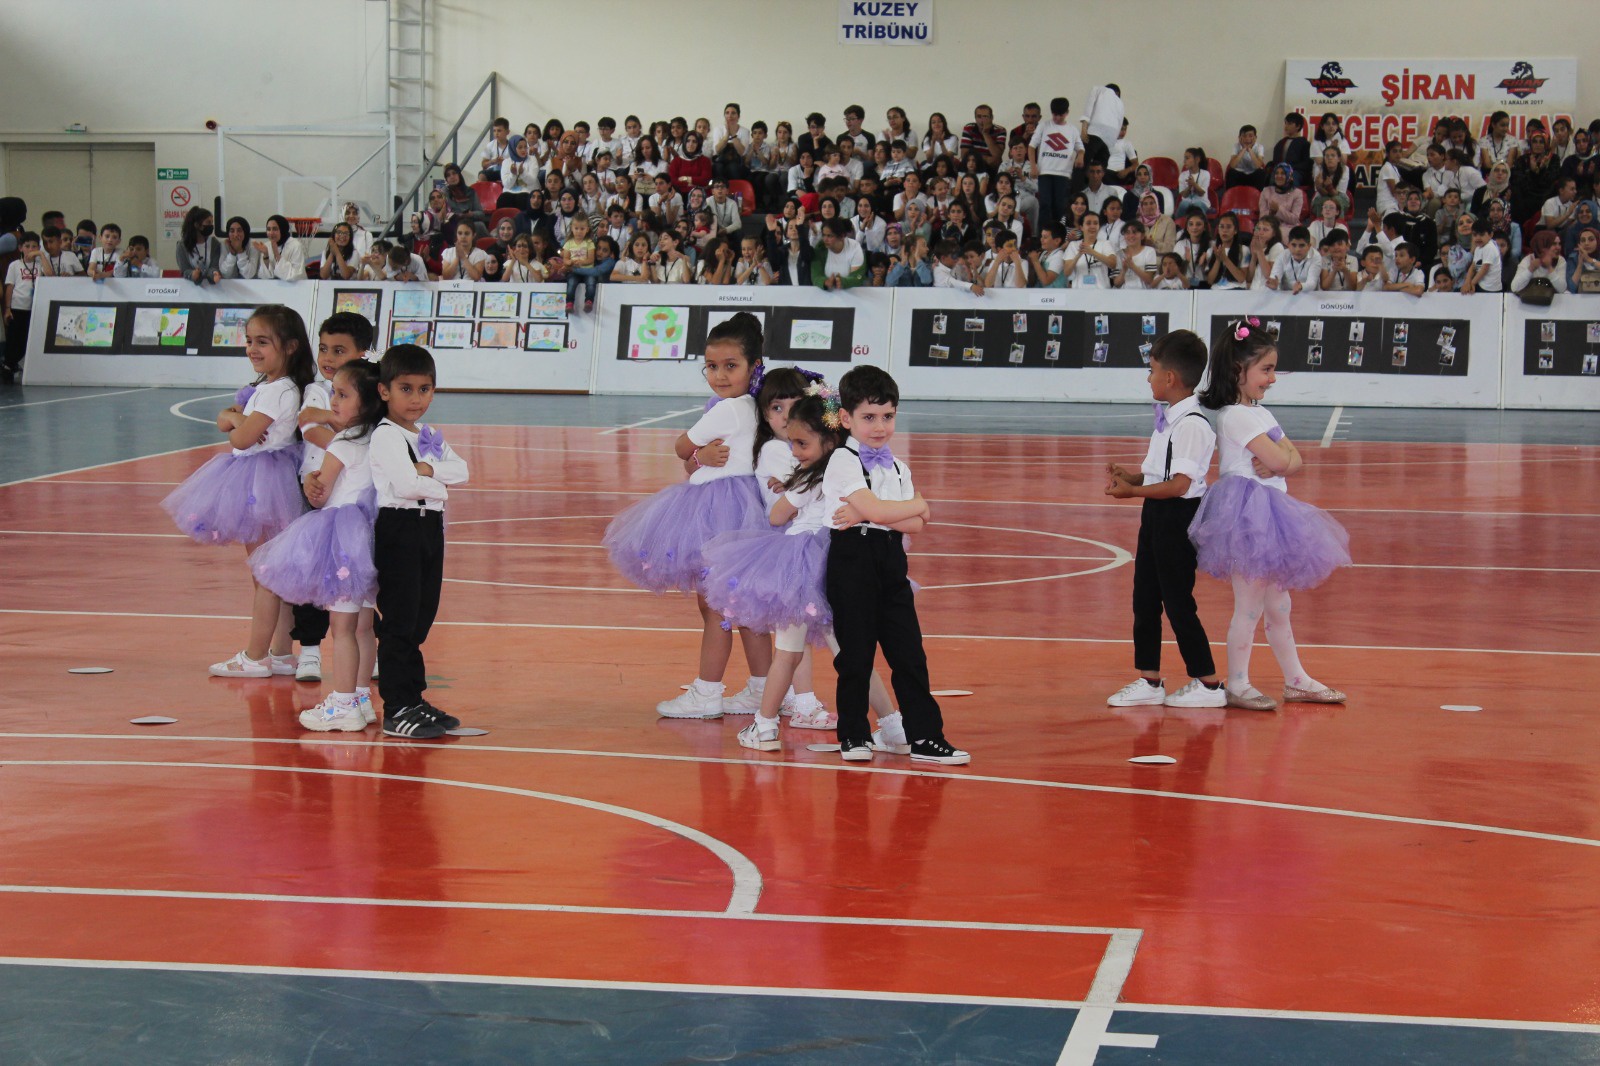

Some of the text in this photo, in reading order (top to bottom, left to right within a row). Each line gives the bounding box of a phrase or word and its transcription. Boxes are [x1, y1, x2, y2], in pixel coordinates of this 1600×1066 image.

[853, 2, 918, 16] KUZEY
[842, 21, 927, 39] TRİBÜNÜ
[1381, 68, 1475, 107] ŞİRAN
[1042, 151, 1068, 159] STADIUM
